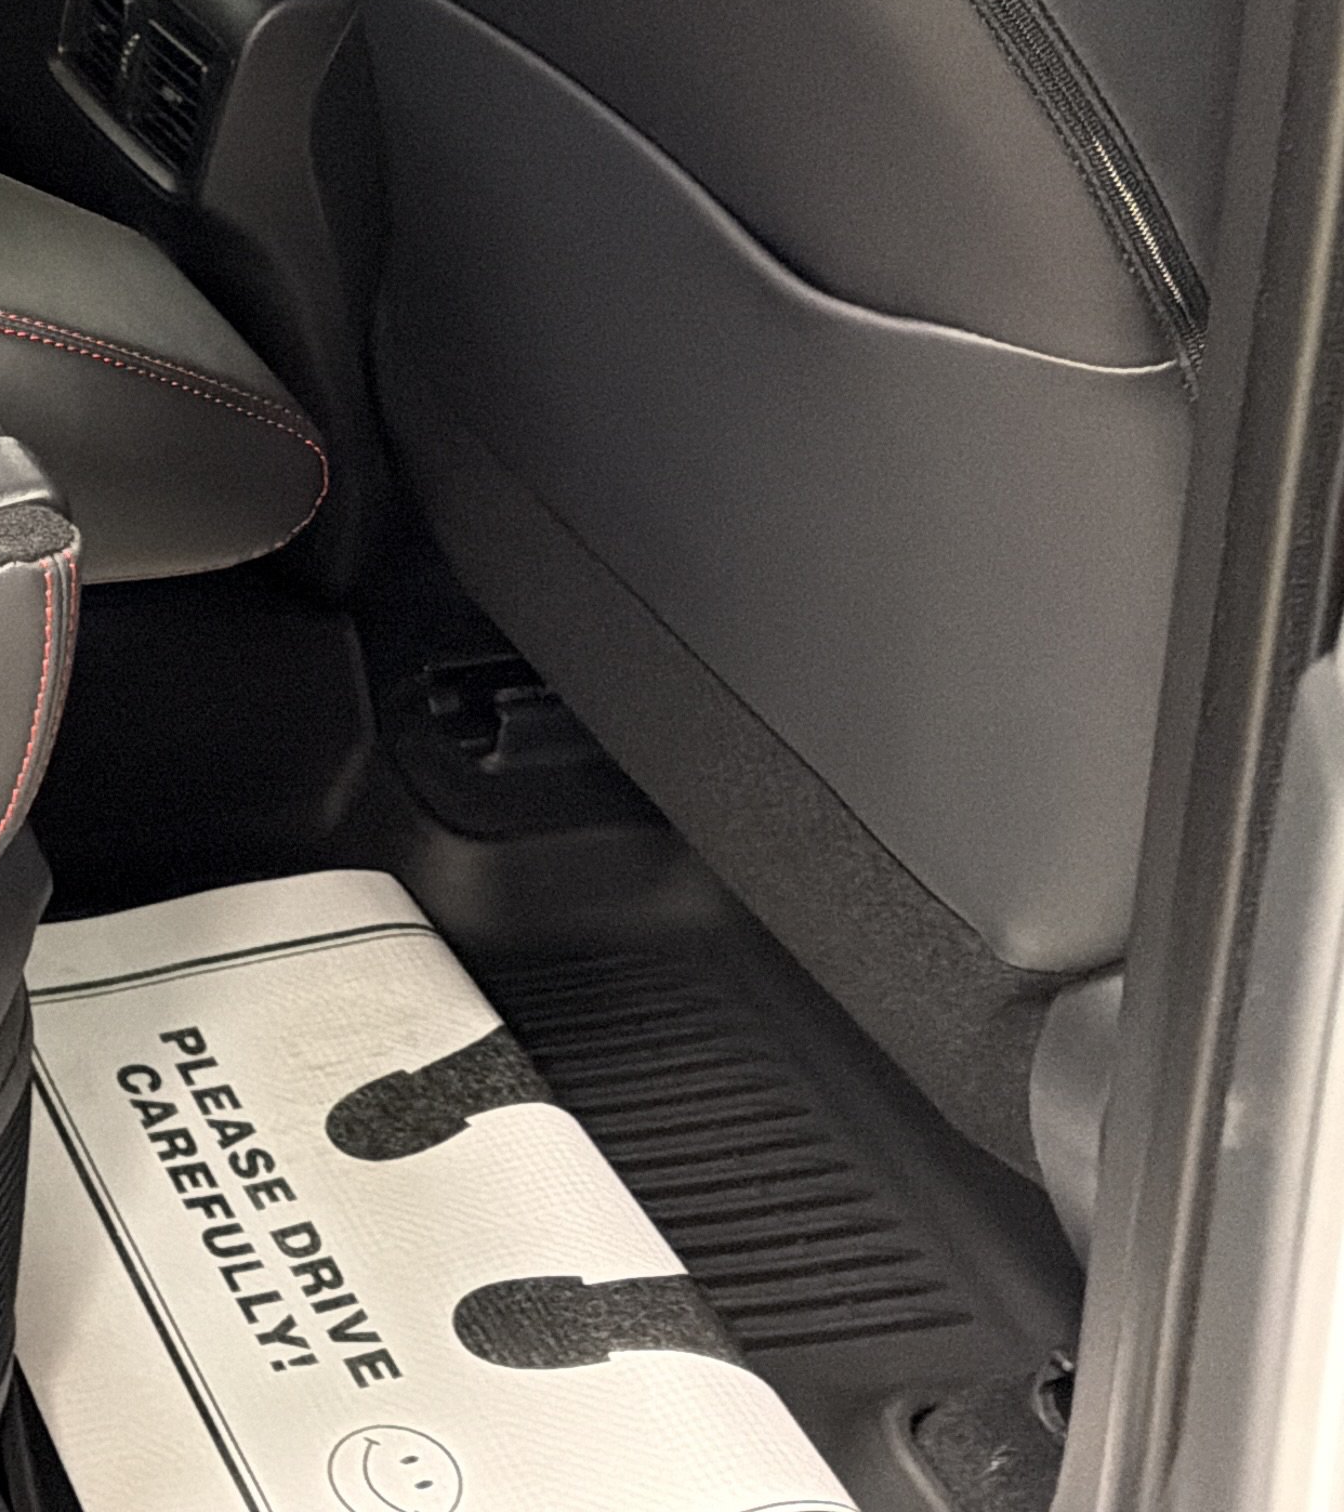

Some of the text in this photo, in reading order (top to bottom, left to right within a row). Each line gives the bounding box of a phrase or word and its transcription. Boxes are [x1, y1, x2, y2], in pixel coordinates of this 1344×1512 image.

[116, 1063, 320, 1372] CAREFULLY!
[158, 1026, 404, 1389] PLEASE DRIVE
